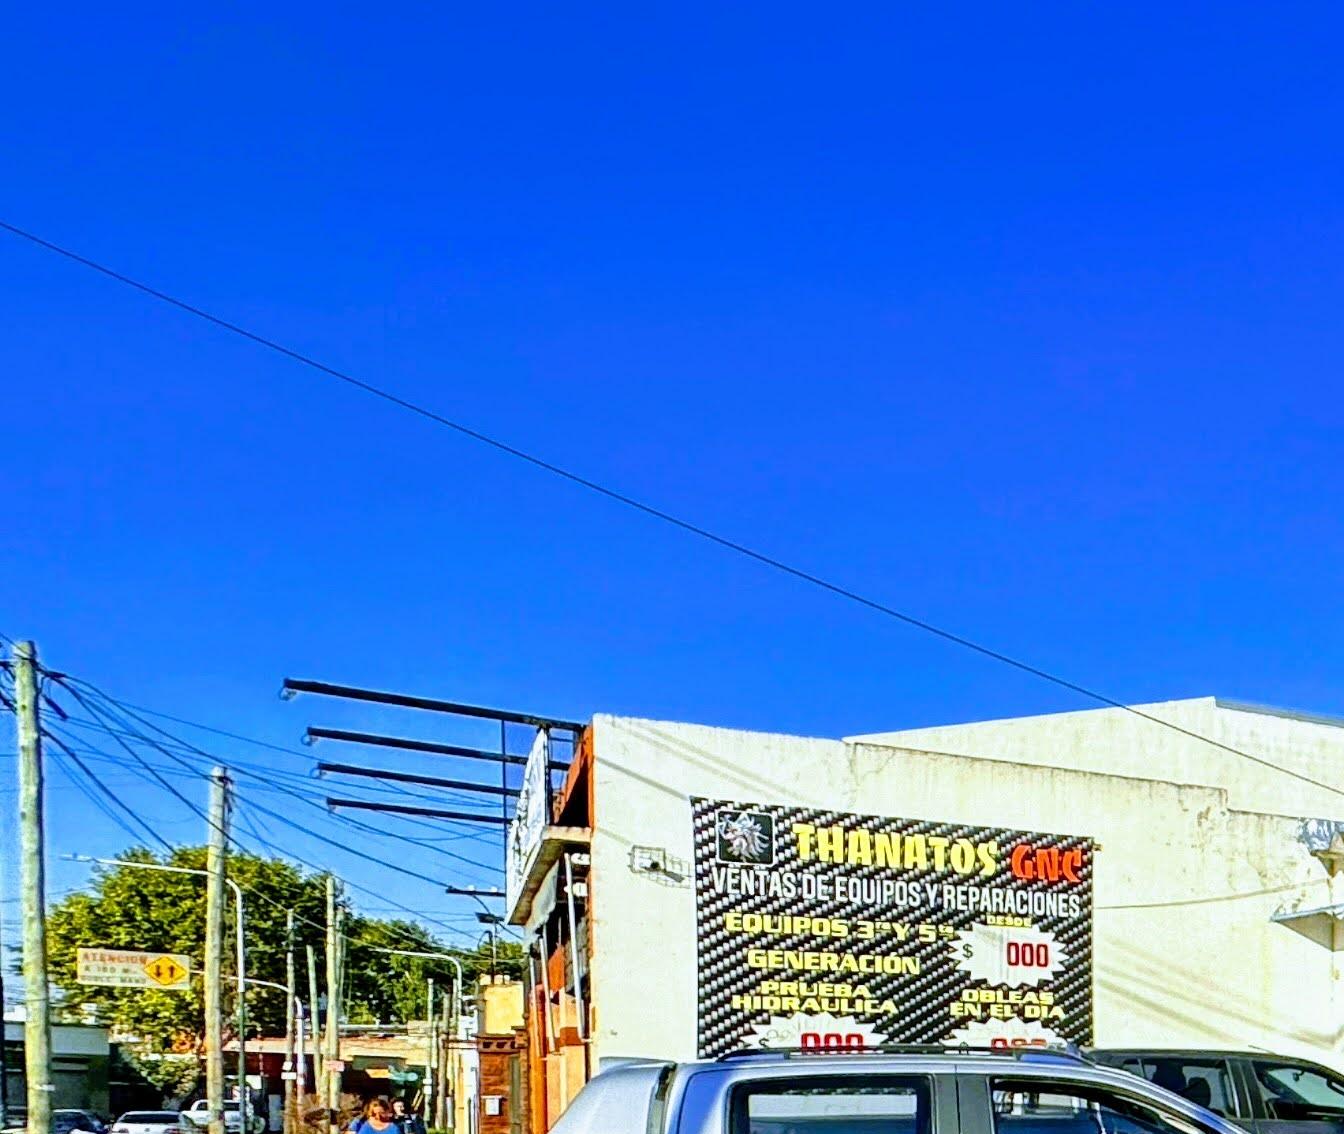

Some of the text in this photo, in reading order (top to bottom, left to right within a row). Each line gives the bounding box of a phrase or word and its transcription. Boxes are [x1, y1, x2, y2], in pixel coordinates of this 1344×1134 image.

[791, 823, 1083, 884] THANATOS GNC
[711, 866, 1081, 918] VENTAS DE EQUIPOS Y REPARACIONES
[726, 912, 849, 937] EQUIPOS
[892, 922, 910, 941] Y
[986, 915, 1032, 928] DESDE
[748, 949, 920, 975] GENERACIÓN
[962, 942, 1049, 968] $ 000
[761, 981, 872, 998] PRUEBA
[962, 989, 1054, 1005] OBLEAS
[732, 995, 899, 1014] HIDRAULICA
[950, 1003, 1065, 1018] EN EL DIA
